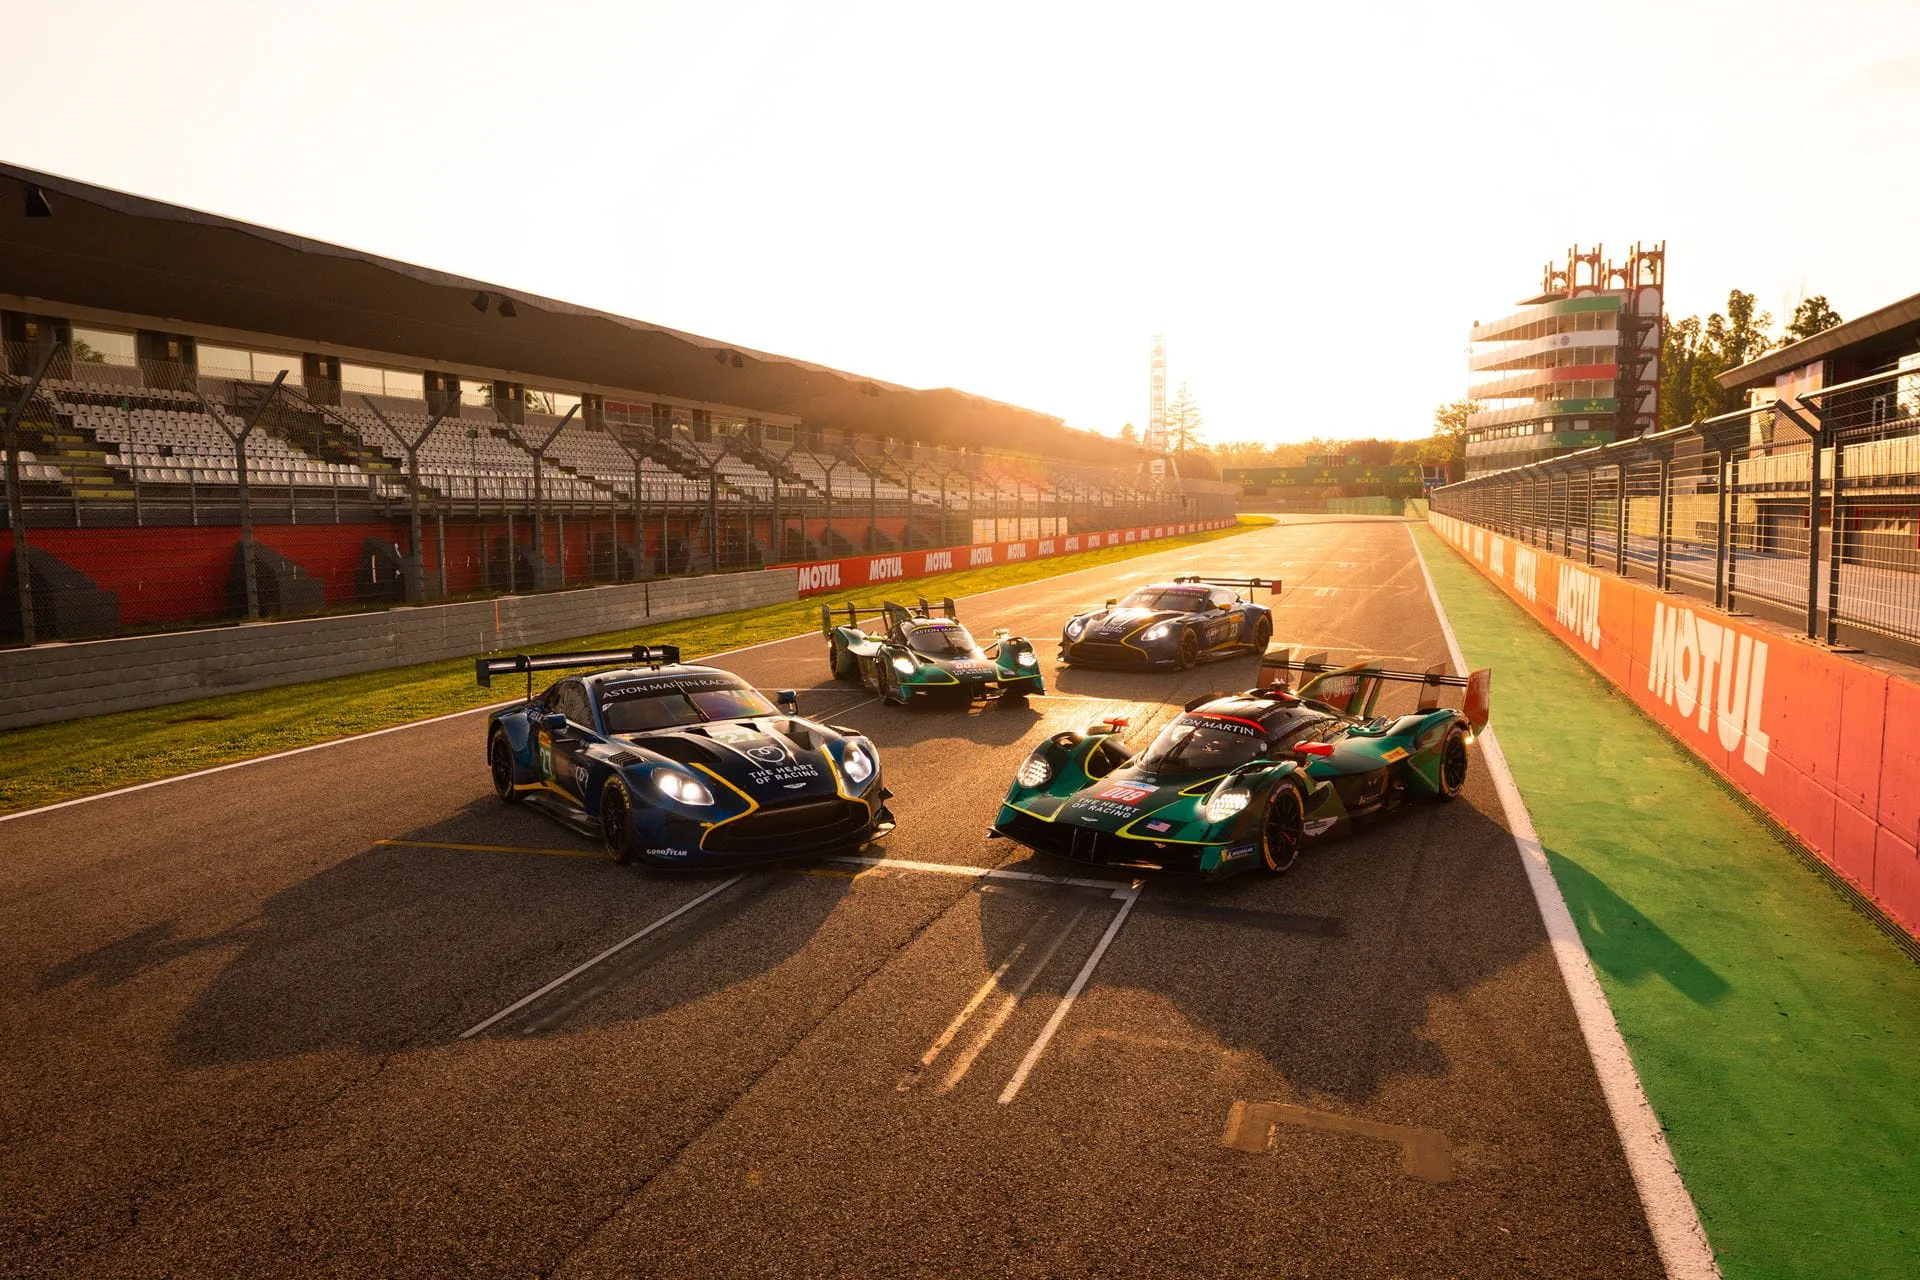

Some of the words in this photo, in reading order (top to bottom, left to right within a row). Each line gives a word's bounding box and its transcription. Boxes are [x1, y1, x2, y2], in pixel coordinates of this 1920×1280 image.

[970, 547, 993, 566] MOTUL
[1007, 543, 1026, 560] MOTUL
[869, 556, 903, 581] MOTUL
[925, 551, 953, 573] MOTUL
[798, 563, 841, 591] MOTUL
[1556, 563, 1601, 651] MOTUL
[1229, 623, 1239, 638] 23
[603, 685, 648, 699] ASTON
[1647, 601, 1770, 777] MOTUL
[1202, 721, 1255, 736] MARTIN
[539, 747, 553, 776] 27
[748, 769, 774, 779] THE
[777, 764, 815, 775] HEART
[756, 777, 772, 785] OF
[775, 769, 819, 781] RACING
[1100, 786, 1146, 801] 009
[1088, 804, 1132, 818] RACING
[1101, 801, 1140, 813] HEART
[646, 847, 688, 856] GOODYEAR
